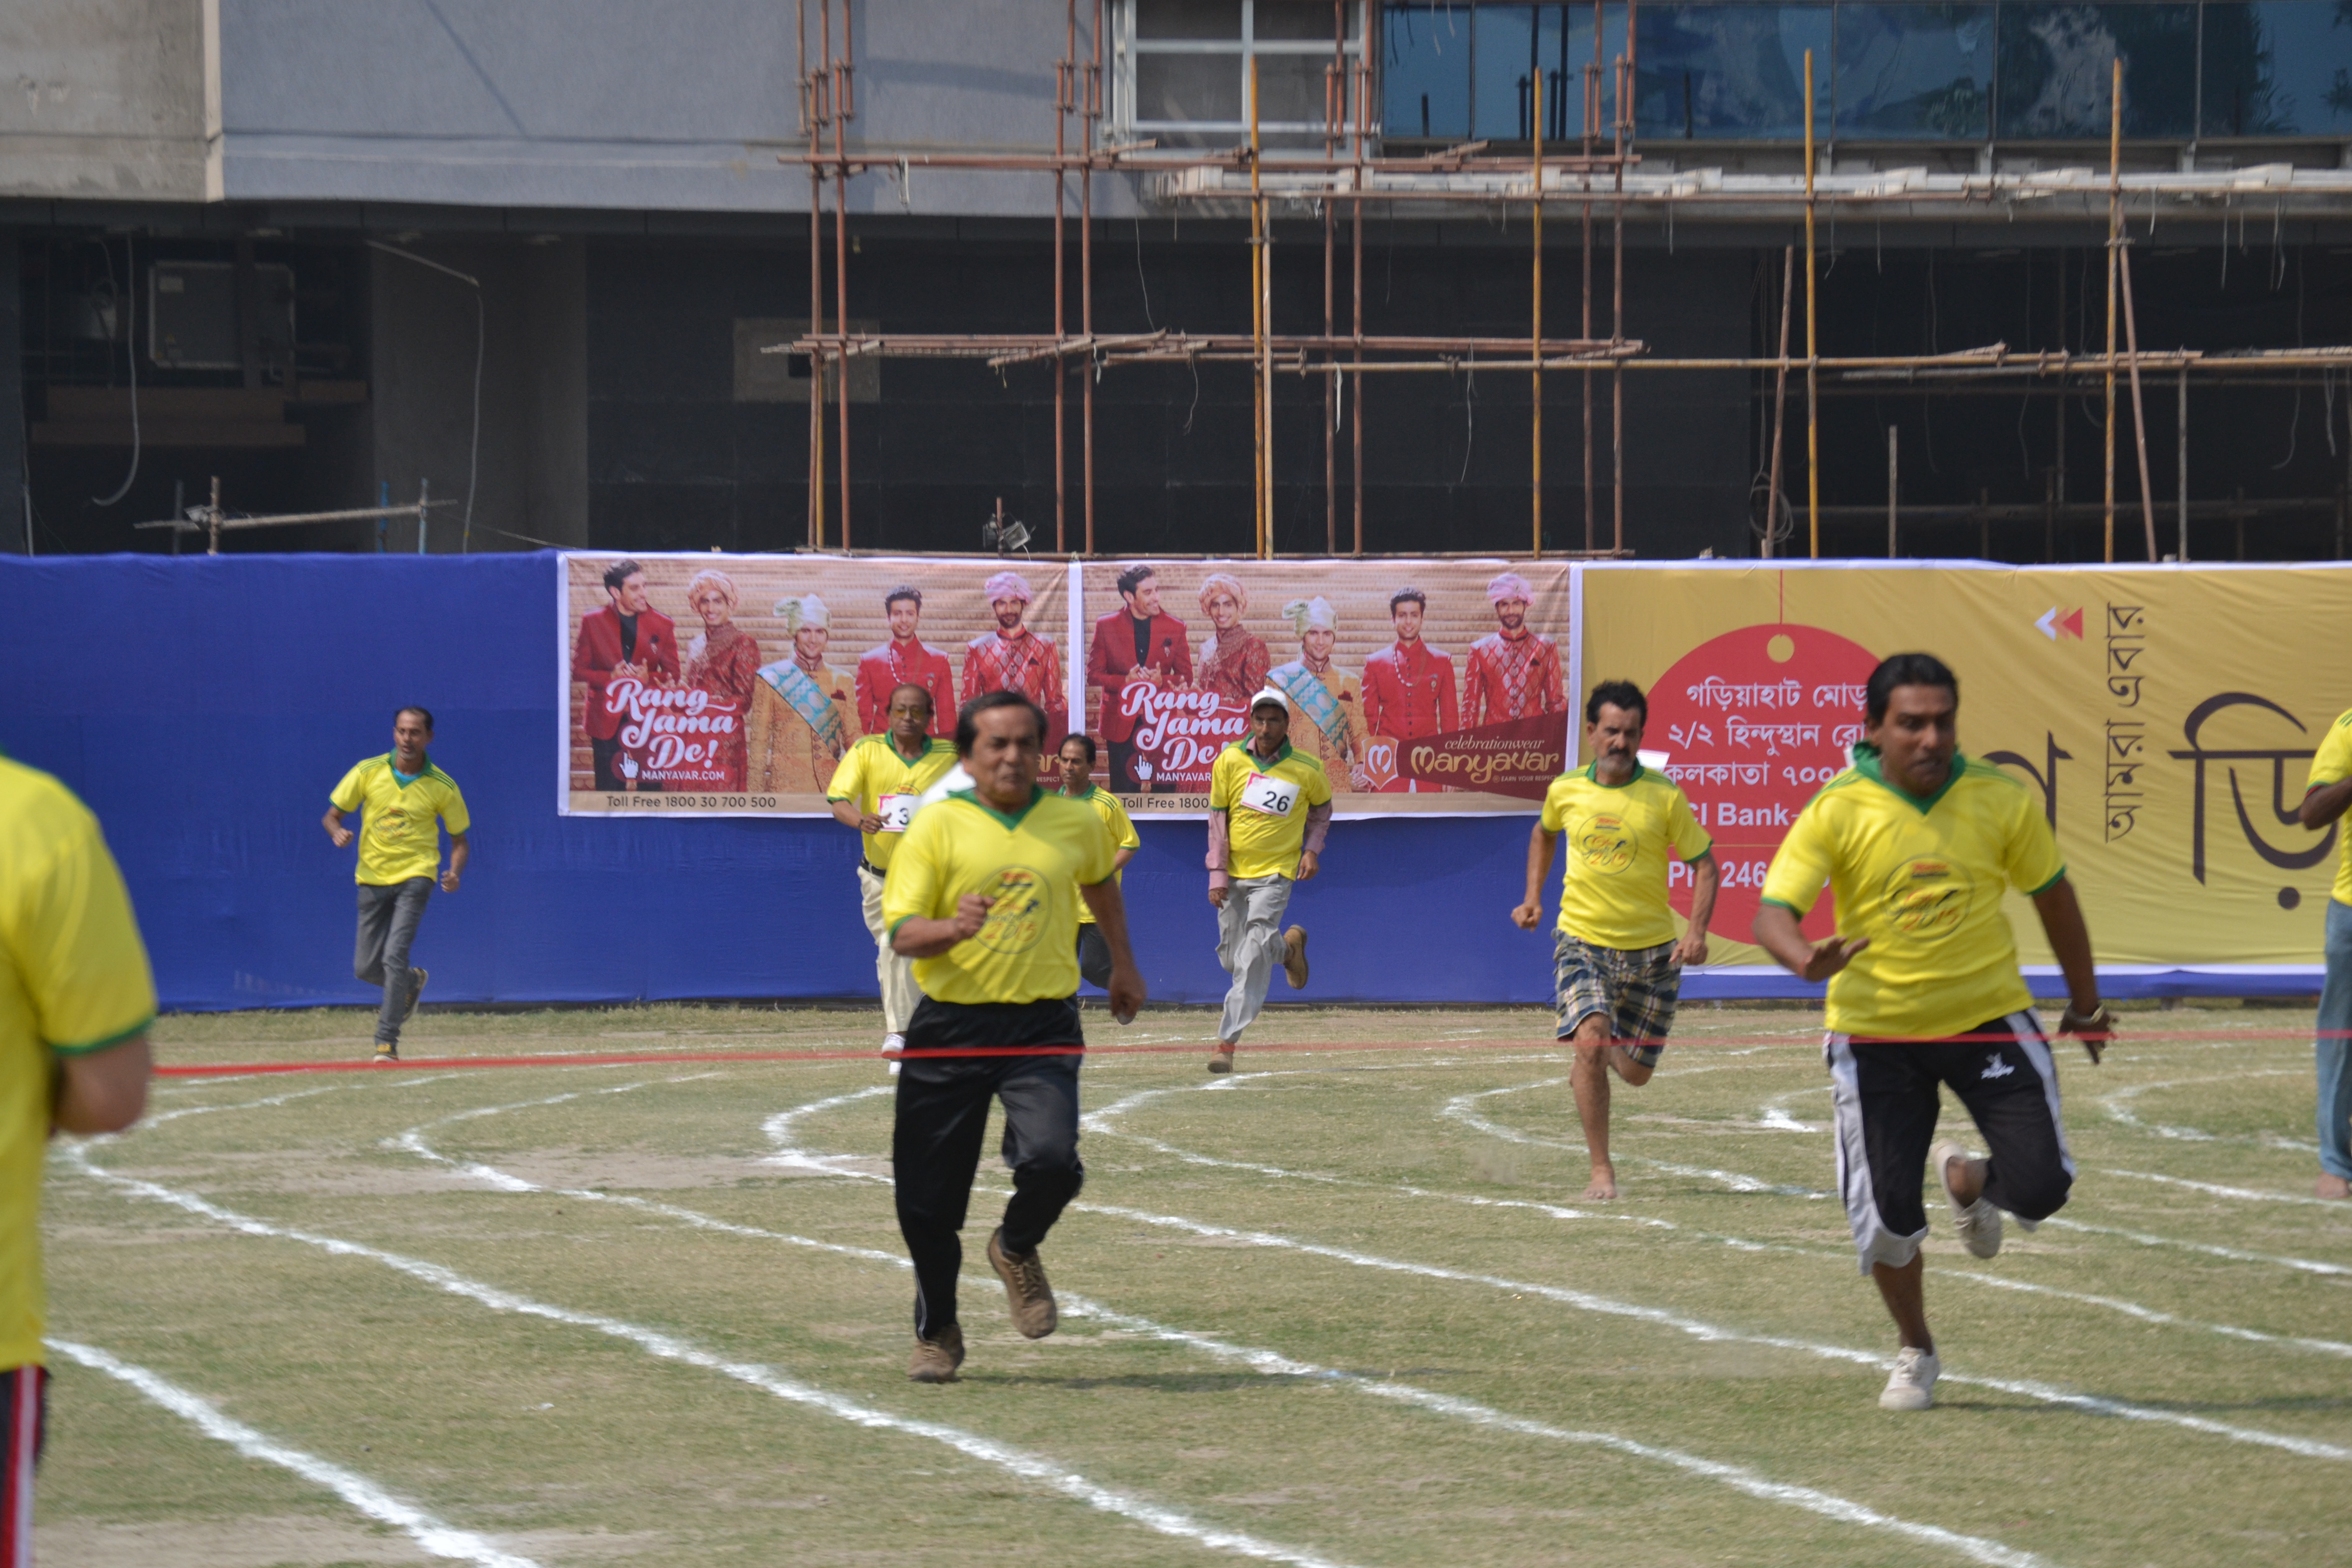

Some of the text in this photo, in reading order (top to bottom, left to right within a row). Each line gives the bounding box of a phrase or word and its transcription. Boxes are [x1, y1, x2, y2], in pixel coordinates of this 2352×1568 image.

[606, 678, 737, 721] Rang
[1121, 681, 1247, 724] Rang
[1686, 675, 1802, 712] গড়িয়াহাট
[621, 707, 738, 748] Jama
[1136, 711, 1248, 751] Jama
[1668, 721, 1714, 750] ২/২
[1832, 721, 1866, 748] রো
[2103, 601, 2145, 844] আমরা এবার
[647, 734, 719, 769] De!
[1445, 735, 1545, 750] celebrationwear
[642, 771, 725, 780] MANYAVAR.COM
[1157, 772, 1212, 782] MANYAVAR
[1664, 761, 1771, 787] কলকাতা
[607, 796, 776, 808] Toll Free 1800 30 700 500
[1121, 798, 1209, 808] Toll Free 1800
[1262, 791, 1290, 812] 26
